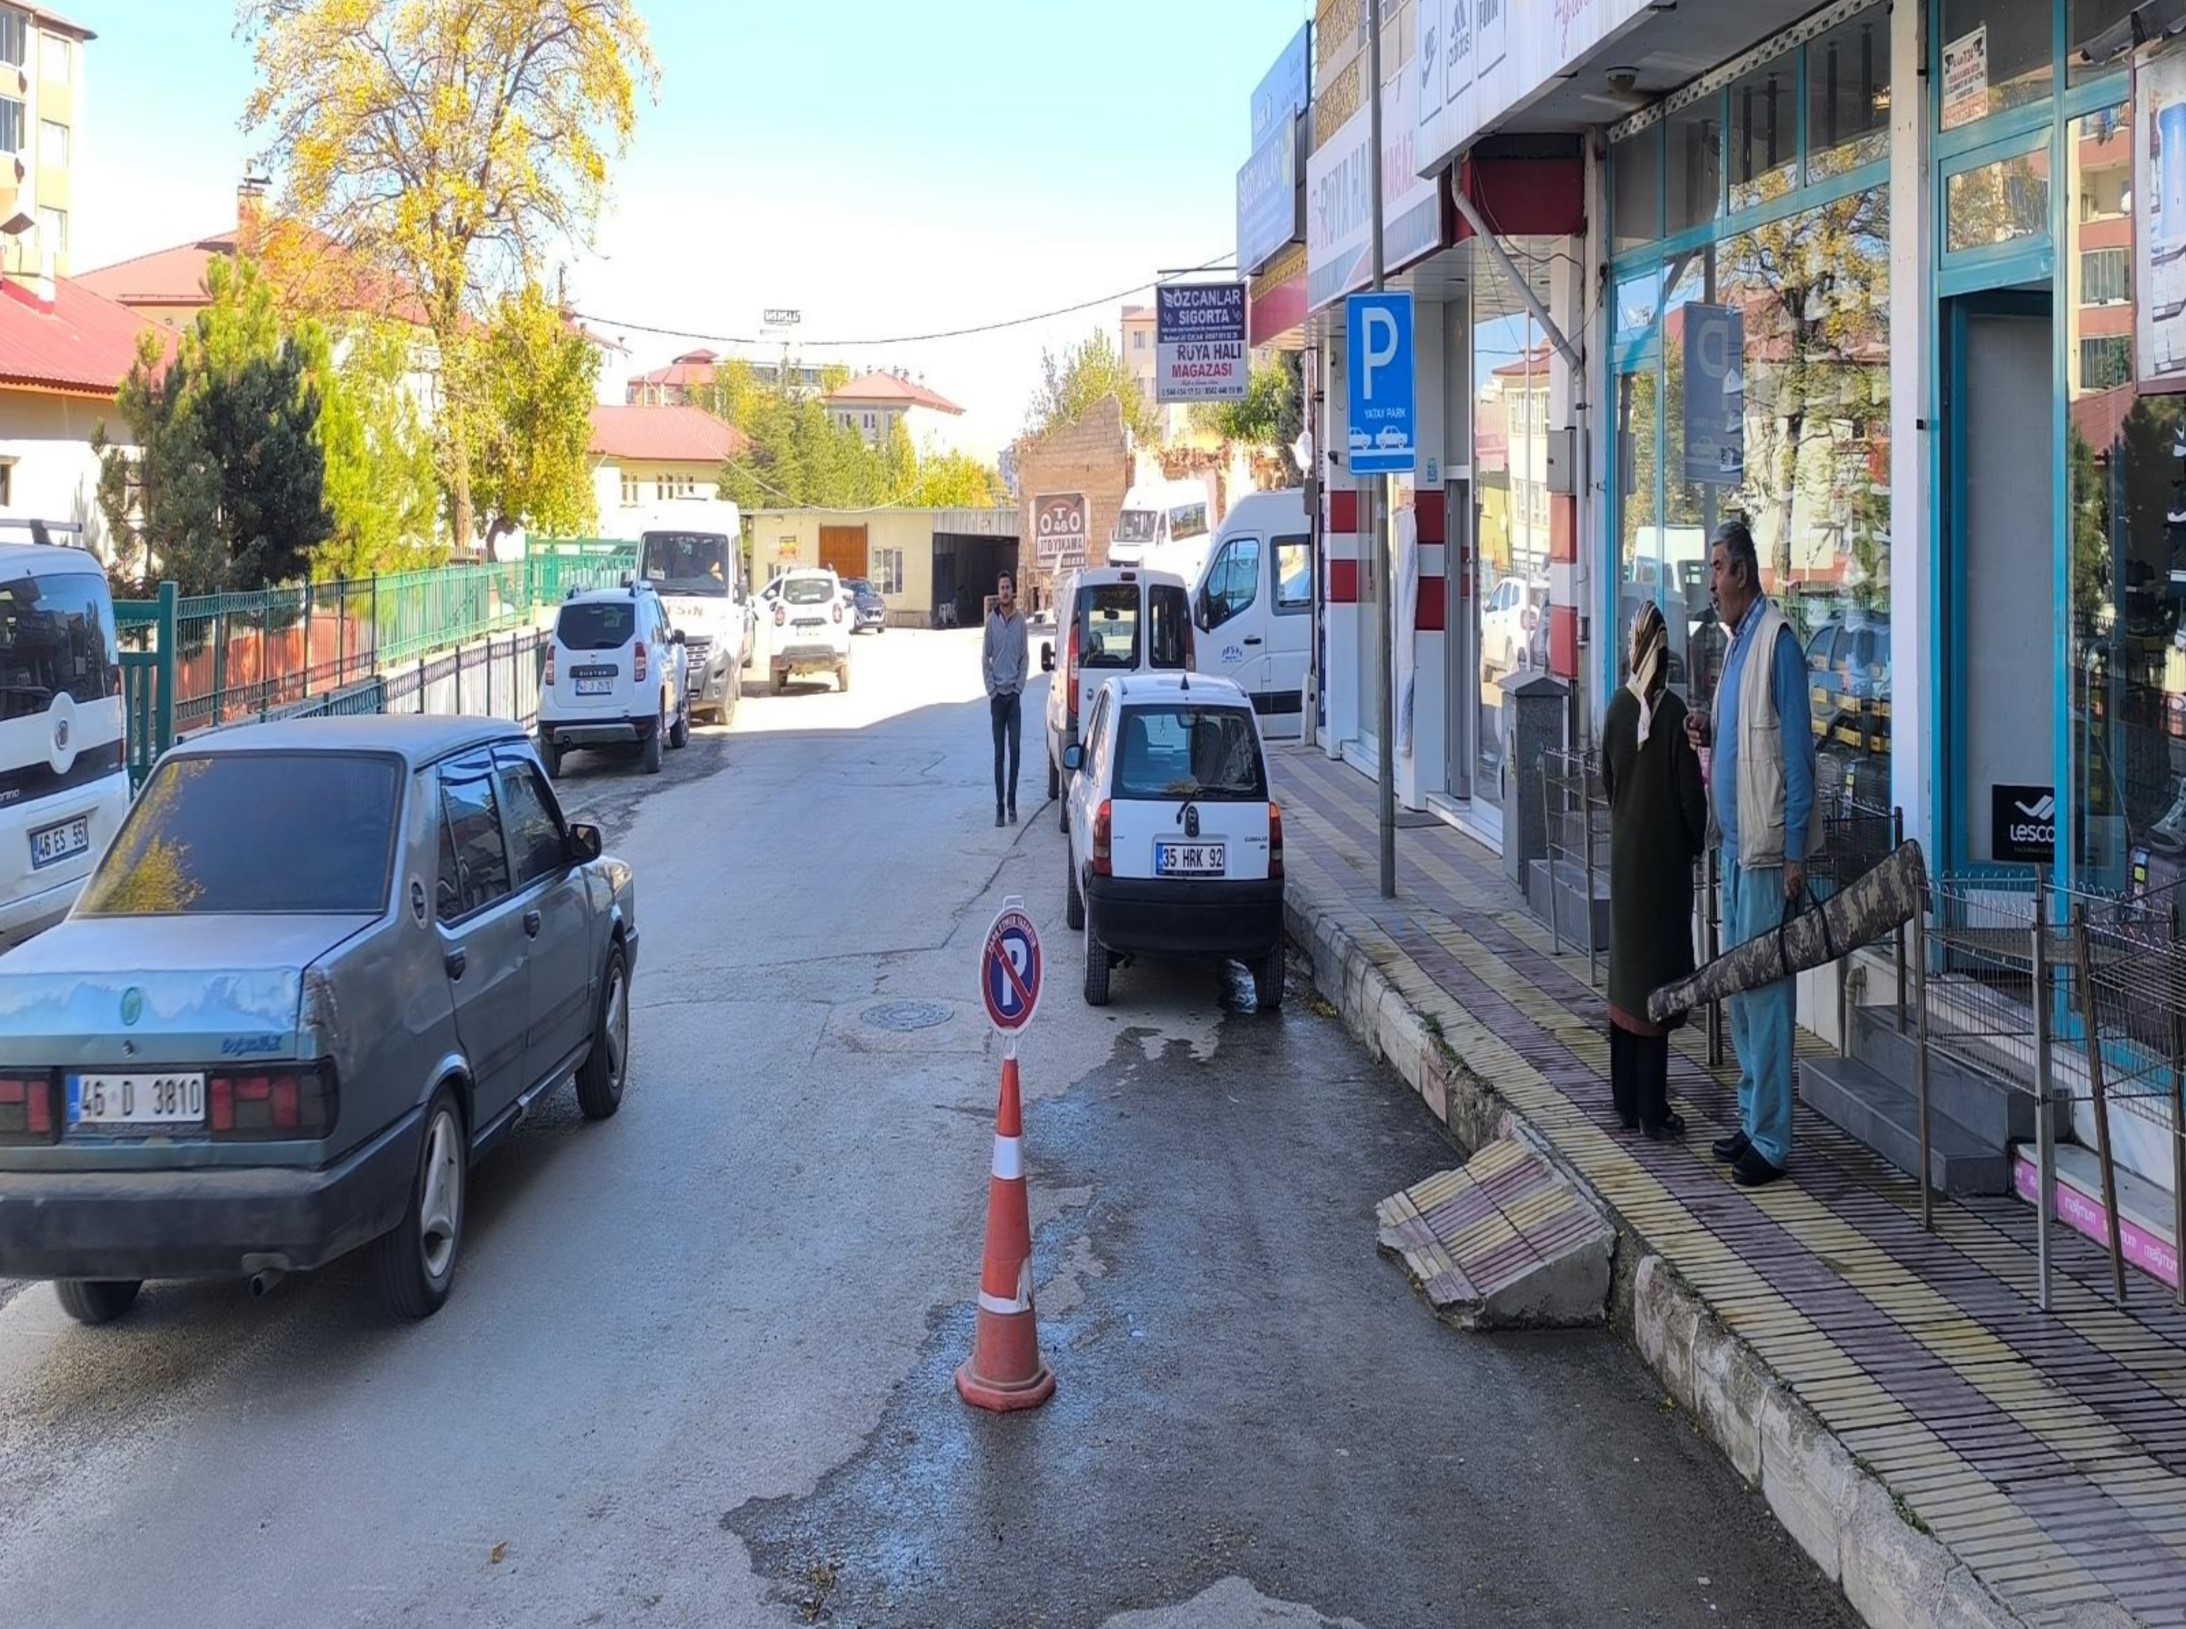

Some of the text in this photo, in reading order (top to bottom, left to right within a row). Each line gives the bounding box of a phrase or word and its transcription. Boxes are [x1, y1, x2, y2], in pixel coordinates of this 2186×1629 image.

[1173, 289, 1241, 307] ÖZCANLAR
[1177, 343, 1242, 361] RÜYA HALI
[1361, 307, 1398, 400] P
[1364, 407, 1406, 420] YATAY PARK
[1053, 520, 1068, 533] 46
[39, 833, 51, 858] 46
[53, 829, 66, 853] ES
[1163, 847, 1223, 867] 35 HRK 92
[1003, 937, 1027, 1007] P
[81, 1078, 201, 1117] 46 D 3810
